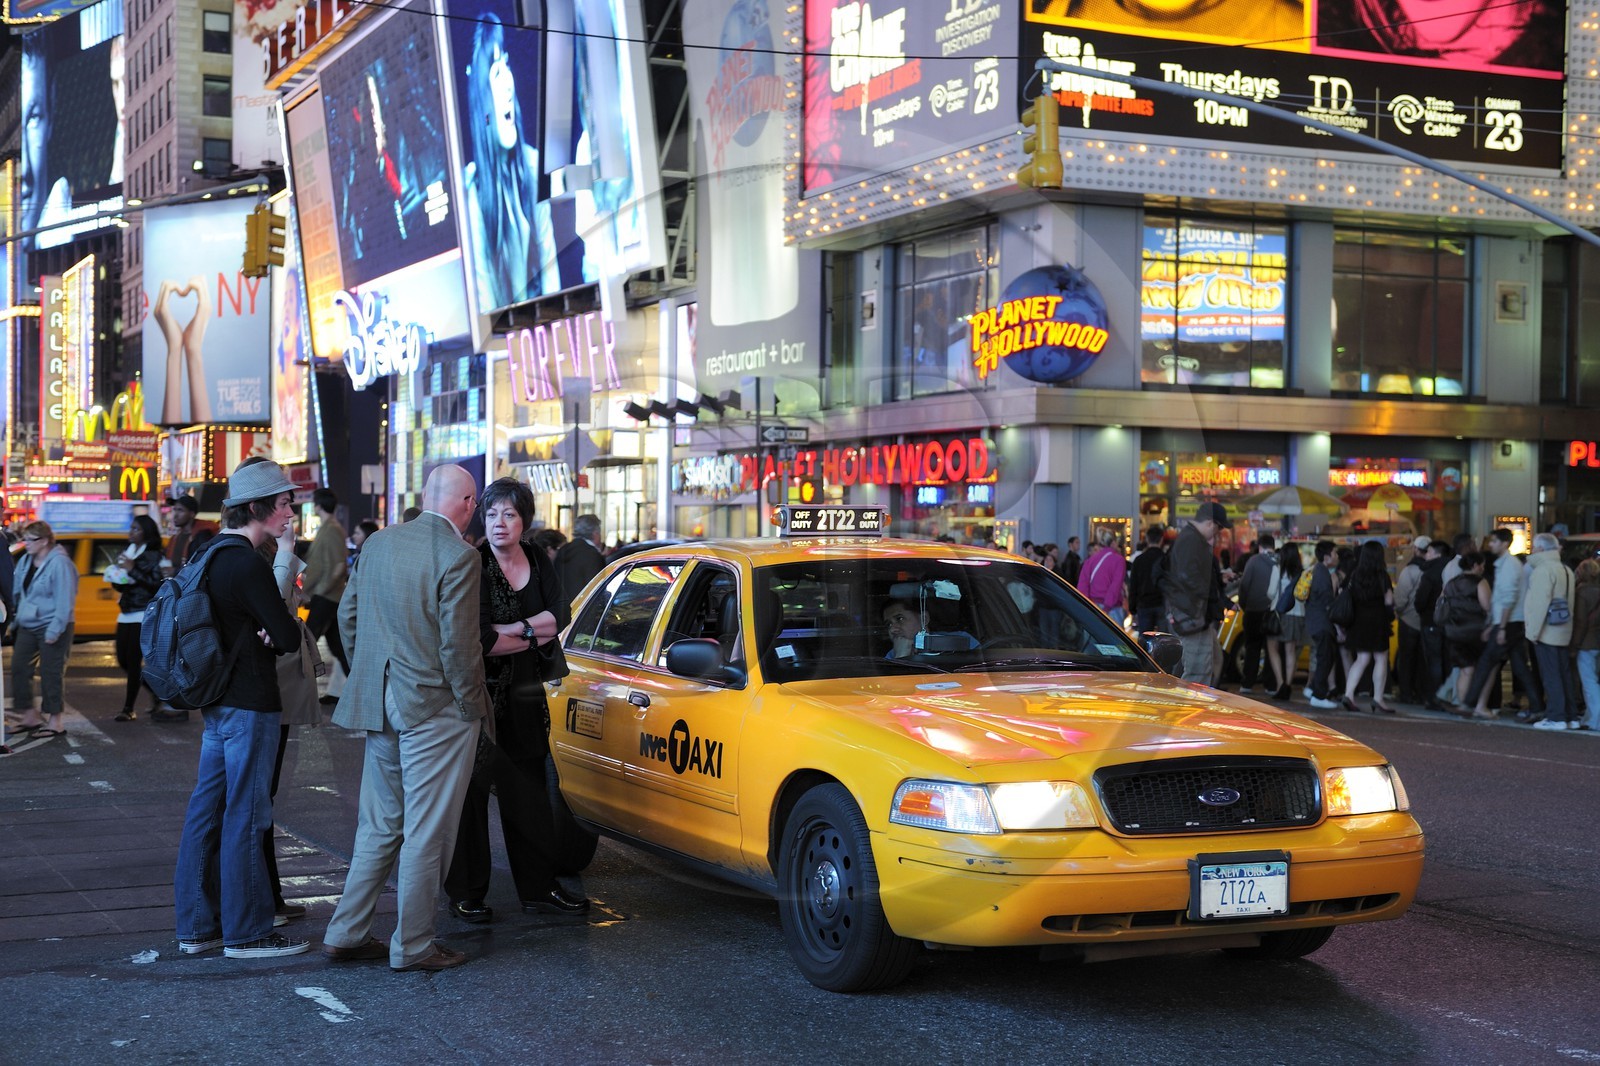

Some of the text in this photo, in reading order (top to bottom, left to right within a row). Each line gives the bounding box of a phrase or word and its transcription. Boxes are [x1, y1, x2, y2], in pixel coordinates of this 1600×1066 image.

[935, 4, 1001, 43] INVESTIGATION
[942, 24, 993, 56] DISCOVERY
[974, 70, 999, 114] 23
[1160, 62, 1280, 102] Thursdays
[872, 96, 921, 127] Thursdays
[1193, 98, 1248, 127] 10PM
[1424, 96, 1455, 112] Time
[1424, 109, 1467, 125] Warner
[1423, 121, 1461, 138] Cable
[1484, 111, 1524, 152] 23
[217, 270, 262, 318] NY
[968, 295, 1064, 353] PLANET
[49, 288, 63, 420] PALACE
[334, 289, 420, 411] Disney
[506, 310, 621, 404] FOREVER
[706, 342, 767, 376] restaurant
[781, 338, 806, 364] bar
[974, 320, 1110, 381] HOLLYWOOD
[767, 430, 804, 439] ONE WAY
[740, 438, 989, 491] PLAET HOLLYWOOD
[1182, 469, 1280, 484] RESTAURANT & BAR
[791, 520, 812, 529] DUTY
[795, 511, 811, 520] OFF
[817, 510, 856, 531] 2T22
[860, 521, 879, 529] DUTY
[863, 512, 878, 520] OFF
[640, 722, 723, 779] NYC TAXI
[1211, 790, 1231, 802] Ford
[1221, 867, 1266, 878] NEW YORK
